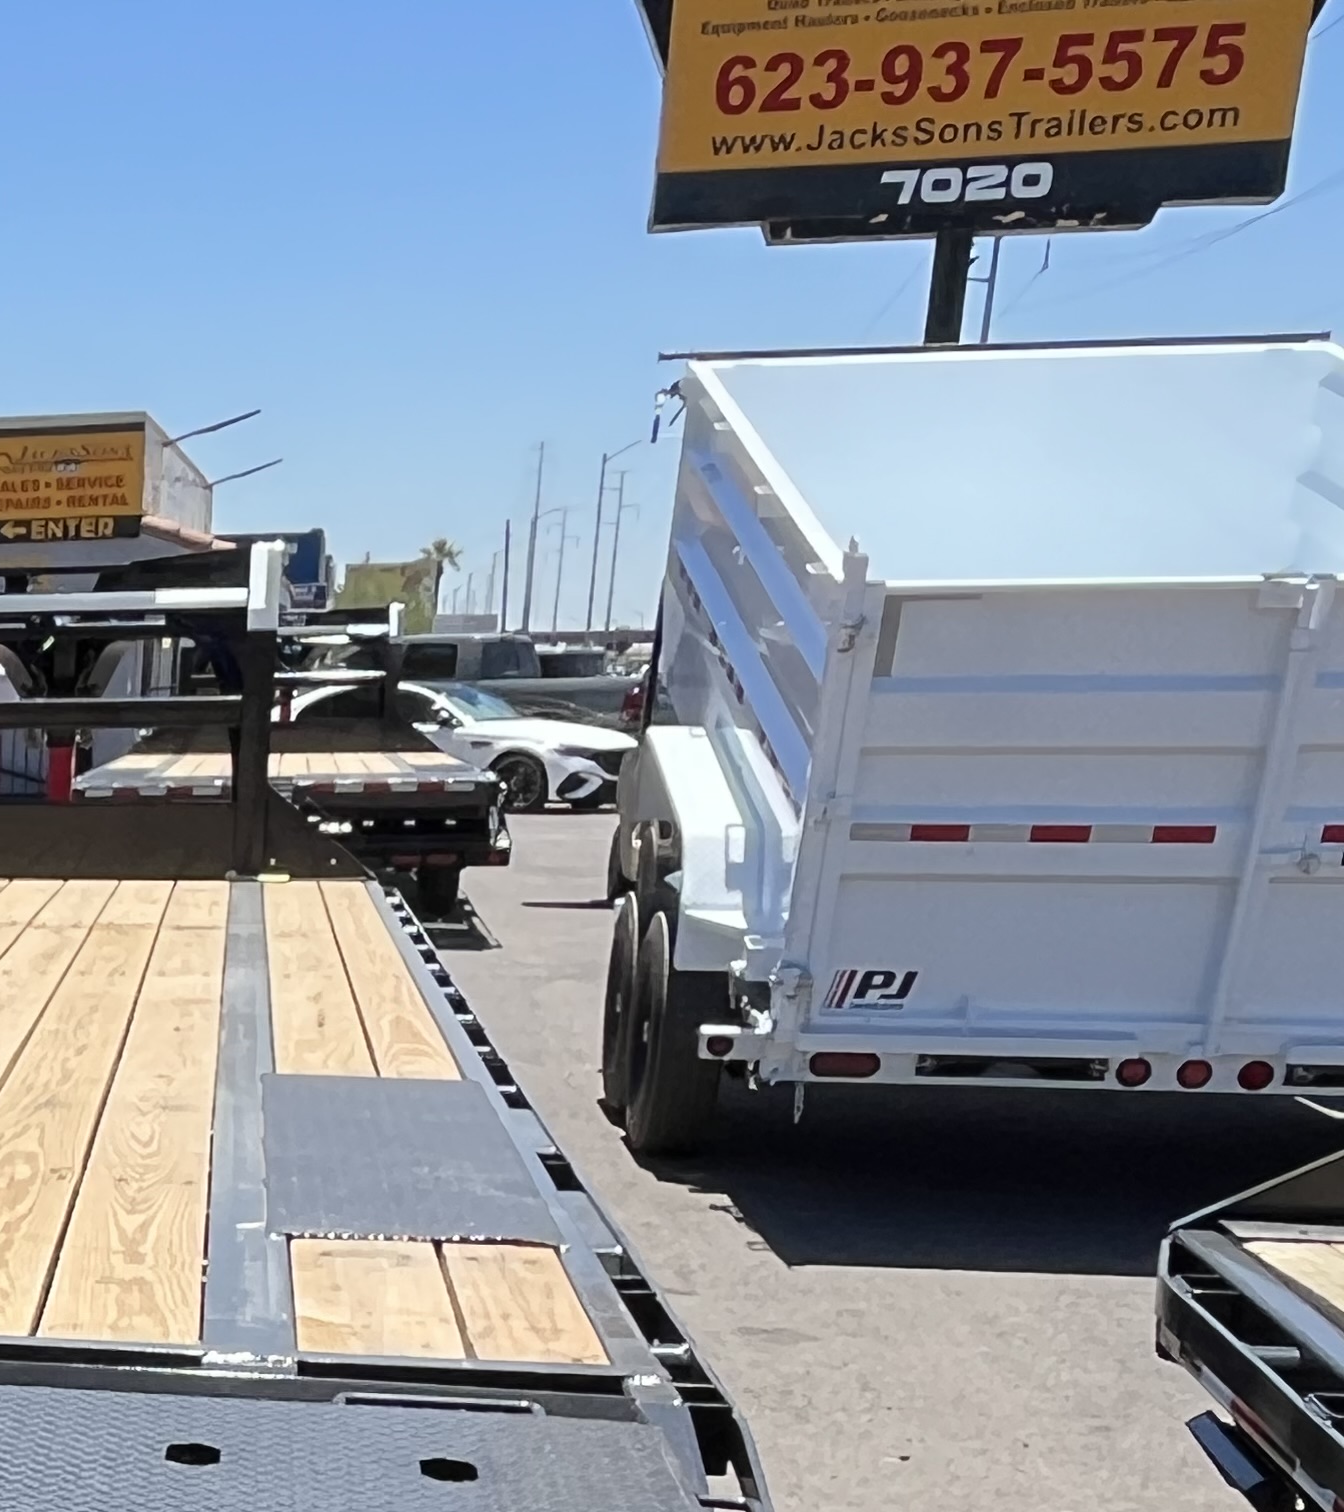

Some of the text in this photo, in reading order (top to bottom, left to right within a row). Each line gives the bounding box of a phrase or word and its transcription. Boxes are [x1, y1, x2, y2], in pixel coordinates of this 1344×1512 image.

[714, 22, 1247, 116] 623-937-5575
[711, 106, 1240, 156] www.JacksSonsTrailers.com
[880, 161, 1054, 205] 7020
[30, 517, 115, 540] ENTER
[853, 970, 919, 1000] PJ
